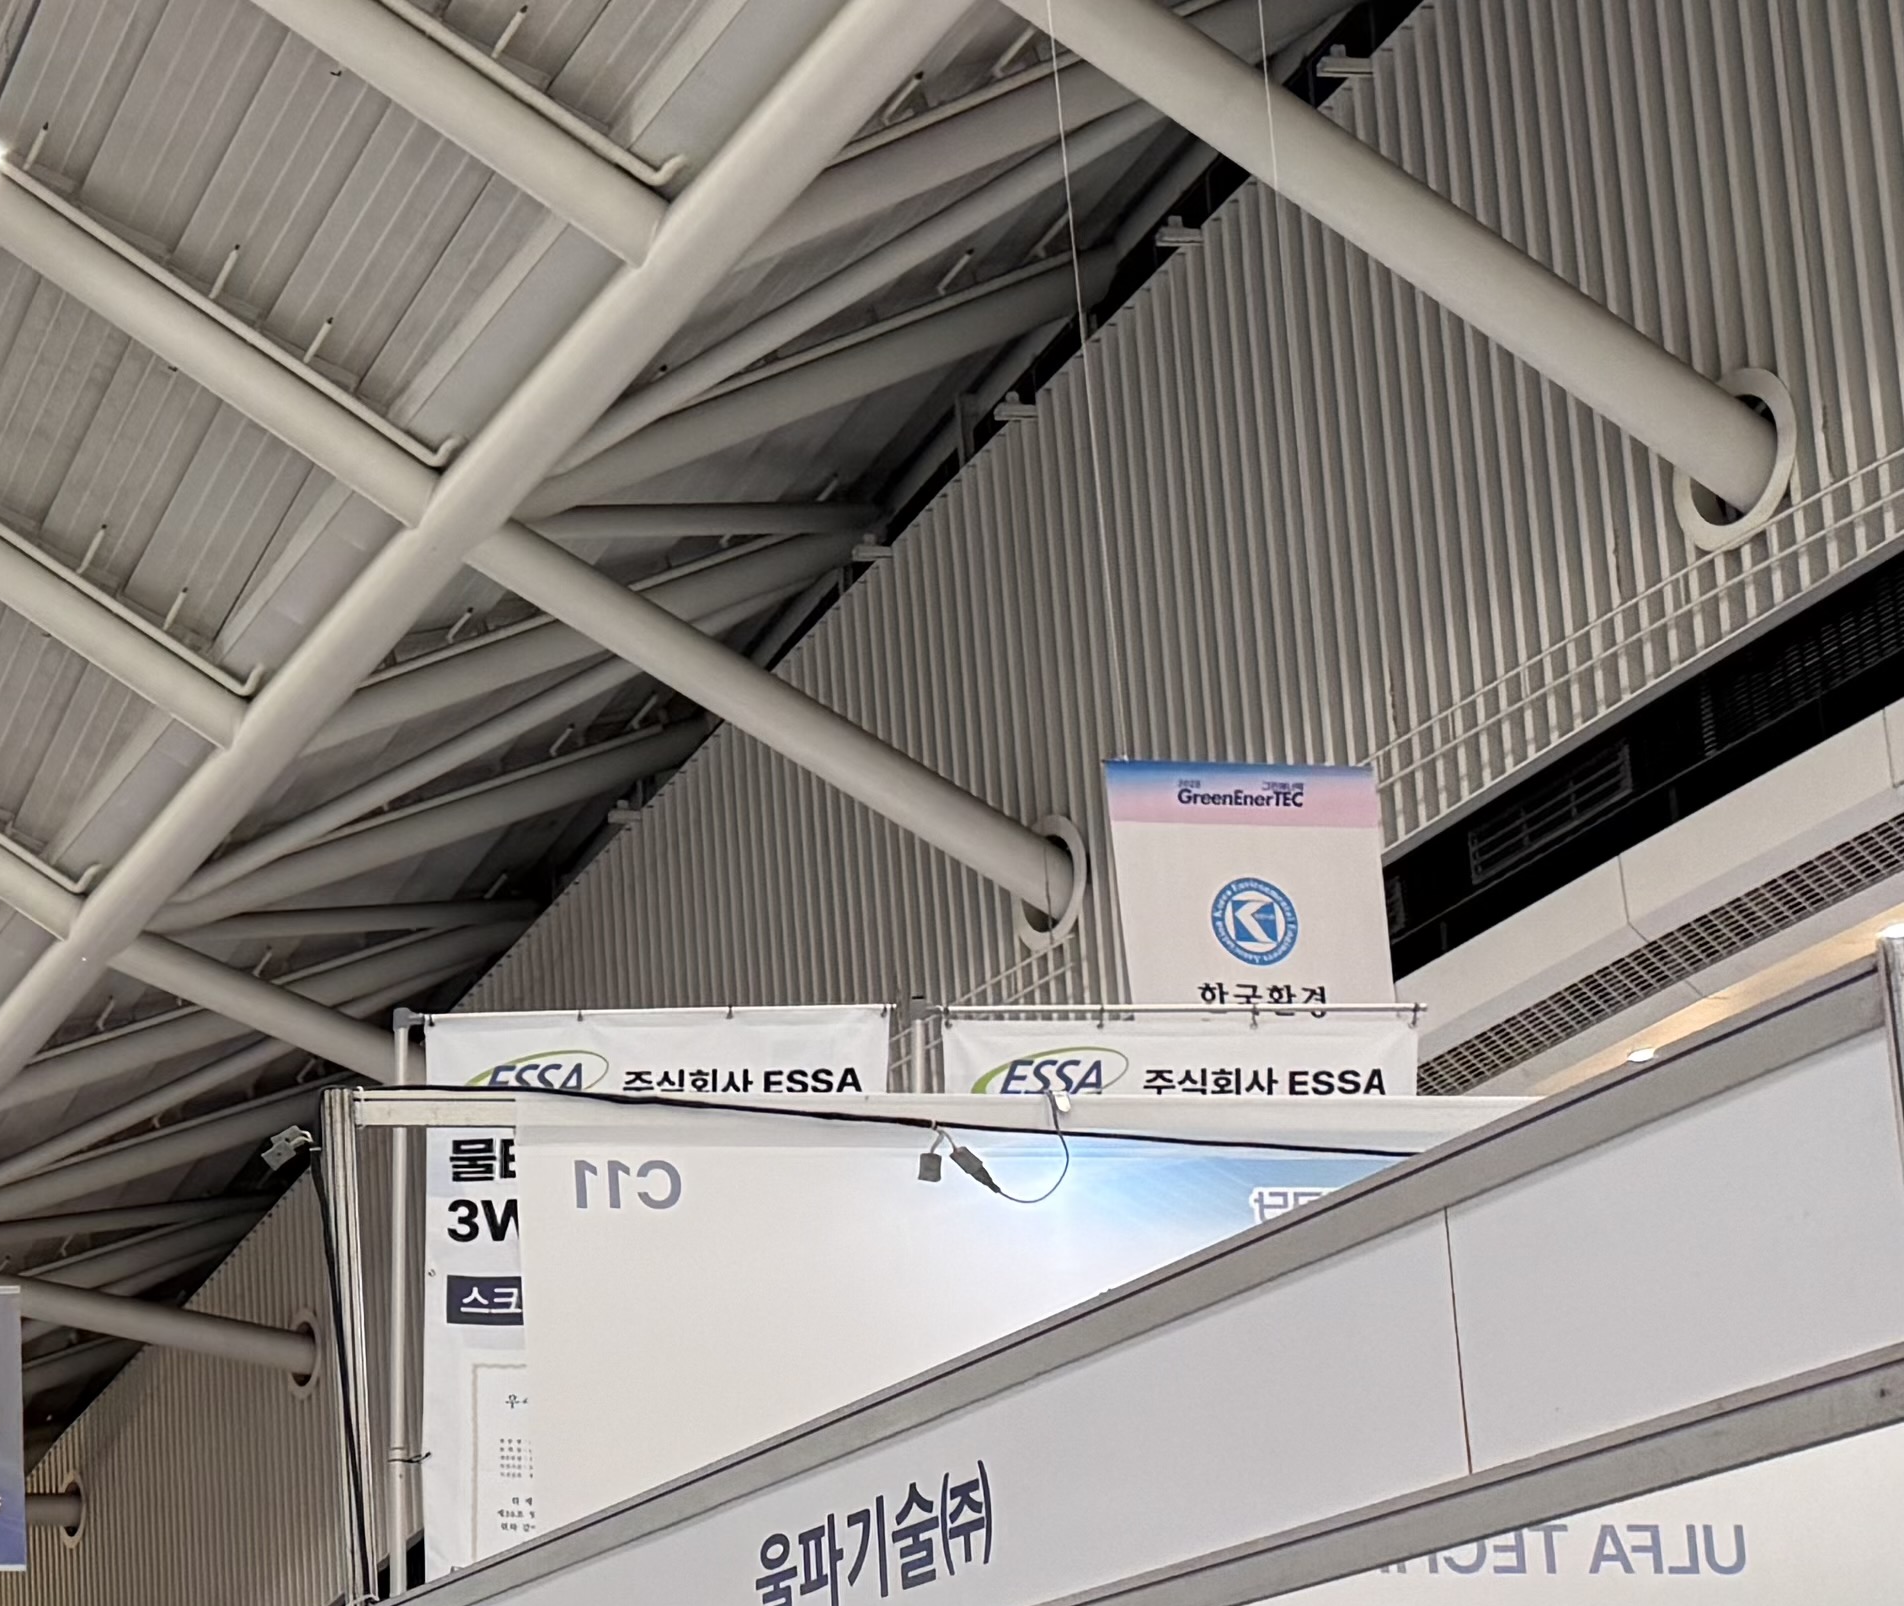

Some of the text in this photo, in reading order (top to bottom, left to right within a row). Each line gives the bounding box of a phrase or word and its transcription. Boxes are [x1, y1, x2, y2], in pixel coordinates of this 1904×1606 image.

[1178, 789, 1304, 807] GreenEnerTEC
[764, 1068, 862, 1093] ESSA
[1000, 1057, 1104, 1093] ESSA
[1285, 1067, 1385, 1095] ESSA
